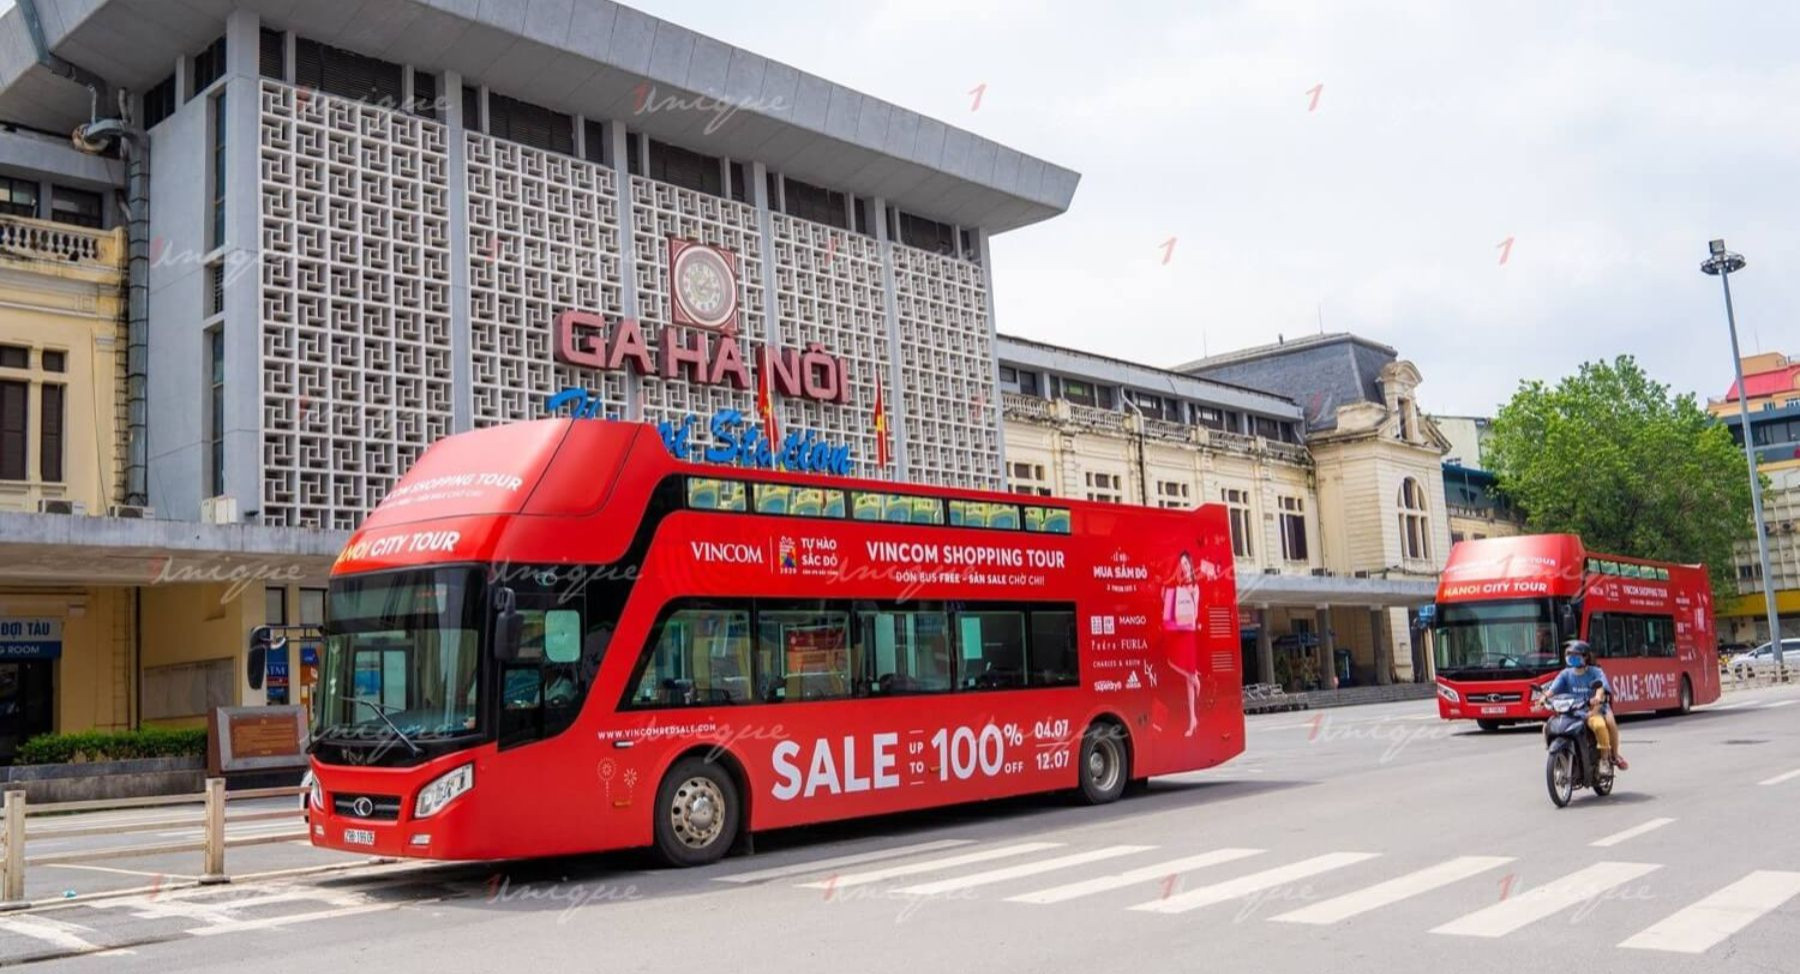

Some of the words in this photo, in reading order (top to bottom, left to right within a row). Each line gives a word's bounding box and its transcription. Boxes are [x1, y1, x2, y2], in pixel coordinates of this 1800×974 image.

[554, 311, 656, 376] GA
[477, 473, 524, 492] TOUR
[370, 534, 406, 557] CITY
[408, 530, 461, 553] TOUR
[691, 541, 763, 564] VINCOM
[866, 541, 939, 563] VINCOM
[943, 545, 1023, 567] SHOPPING
[1026, 549, 1065, 568] TOUR
[939, 573, 961, 584] FREE
[987, 574, 1007, 585] SALE
[1093, 565, 1113, 578] MUA
[1444, 585, 1480, 597] HANOI
[1483, 582, 1510, 593] CITY
[1513, 581, 1548, 592] TOUR
[27, 618, 51, 636] TÀU
[1119, 615, 1147, 625] MANGO
[7, 645, 40, 654] ROOM
[1121, 639, 1148, 650] FURLA
[1093, 660, 1117, 668] CHARLES
[1612, 674, 1639, 702] SALE
[1035, 718, 1069, 739] 04.07
[771, 732, 900, 801] SALE
[909, 742, 924, 754] UP
[909, 762, 924, 774] TO
[1004, 761, 1024, 774] OFF
[1036, 750, 1069, 770] 12.07
